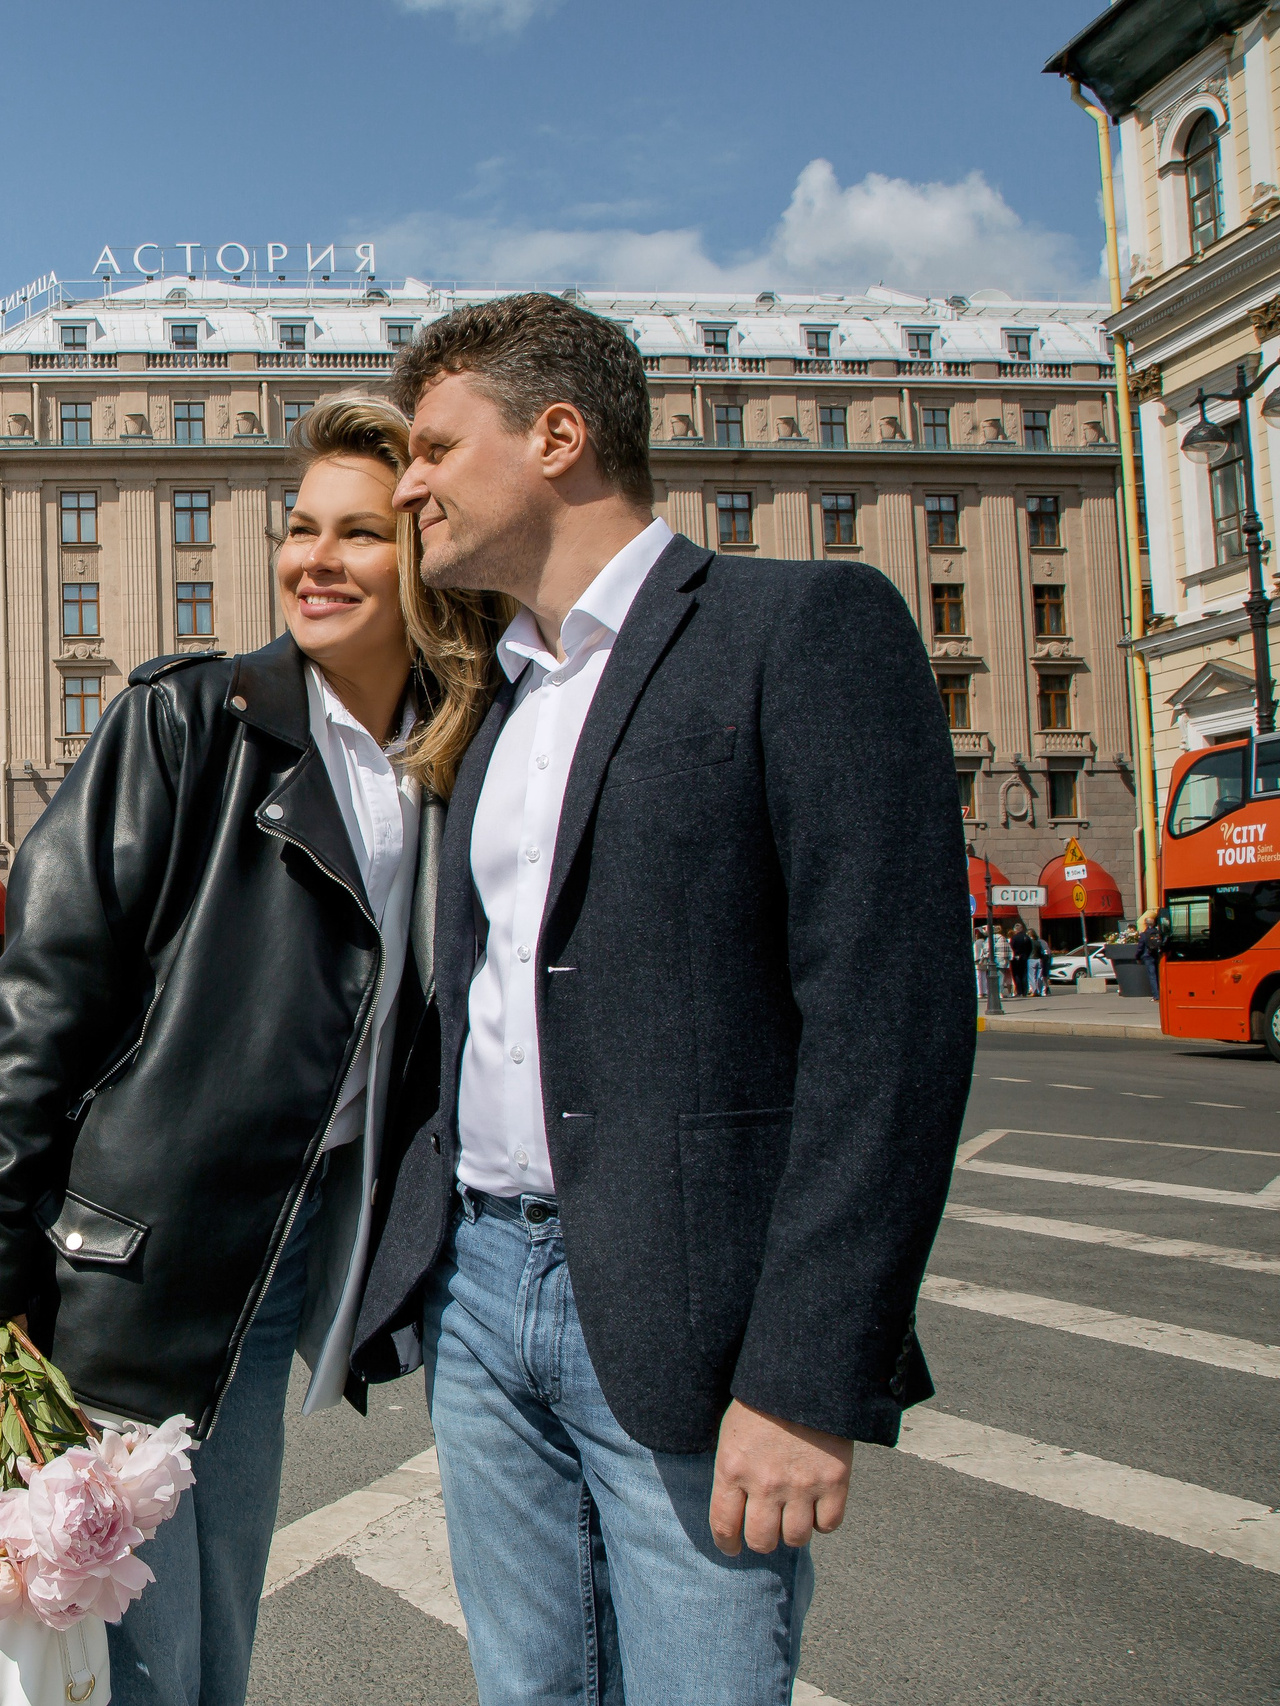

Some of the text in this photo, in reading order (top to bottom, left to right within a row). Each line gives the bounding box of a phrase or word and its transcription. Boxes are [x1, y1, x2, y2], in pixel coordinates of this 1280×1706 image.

[92, 242, 376, 275] АСТОРИЯ
[1232, 823, 1267, 845] CITY
[1257, 844, 1273, 853] Saint
[1216, 846, 1256, 867] TOUR
[1257, 852, 1280, 863] Petersb
[1000, 889, 1038, 902] СТОП
[1075, 892, 1083, 902] 40
